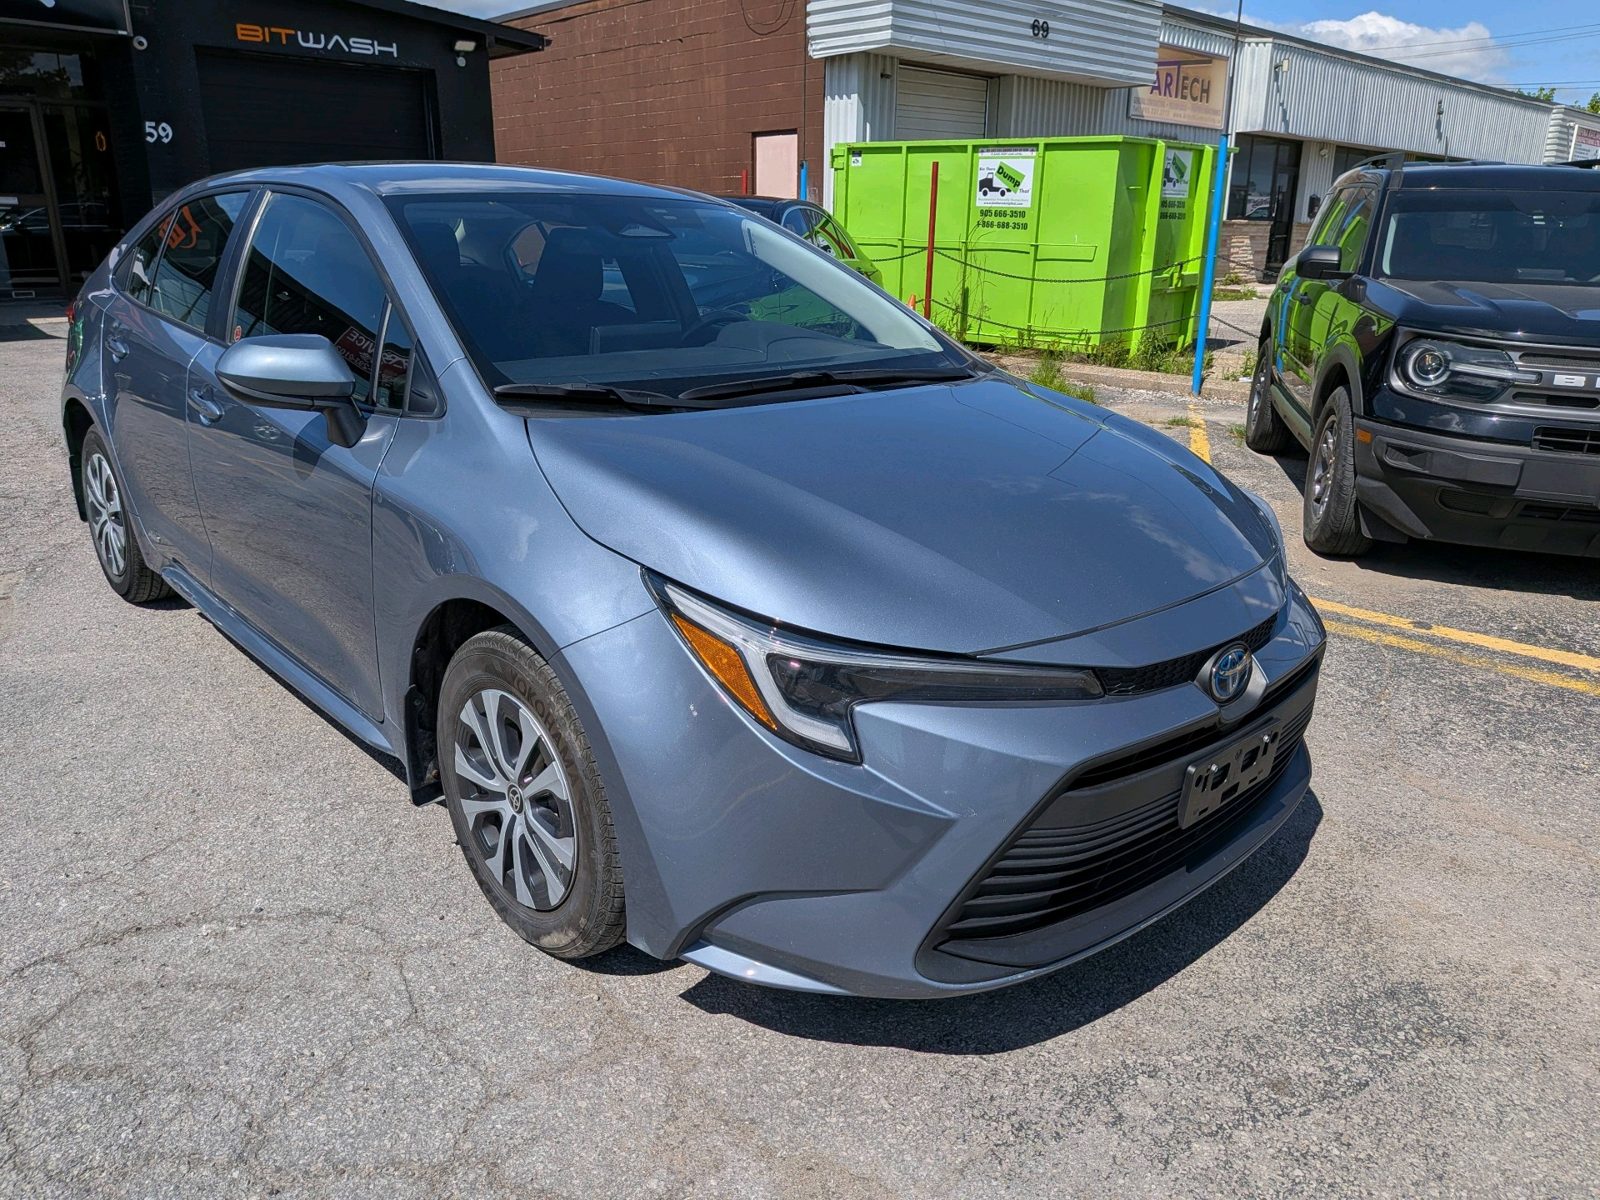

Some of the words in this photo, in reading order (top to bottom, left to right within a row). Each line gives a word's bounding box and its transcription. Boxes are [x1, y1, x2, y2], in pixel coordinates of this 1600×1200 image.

[1031, 18, 1050, 39] 69
[236, 23, 398, 58] BITWASH
[145, 121, 173, 144] 59
[996, 165, 1021, 188] Dump
[979, 209, 993, 218] 905
[993, 209, 1026, 219] 666-3510
